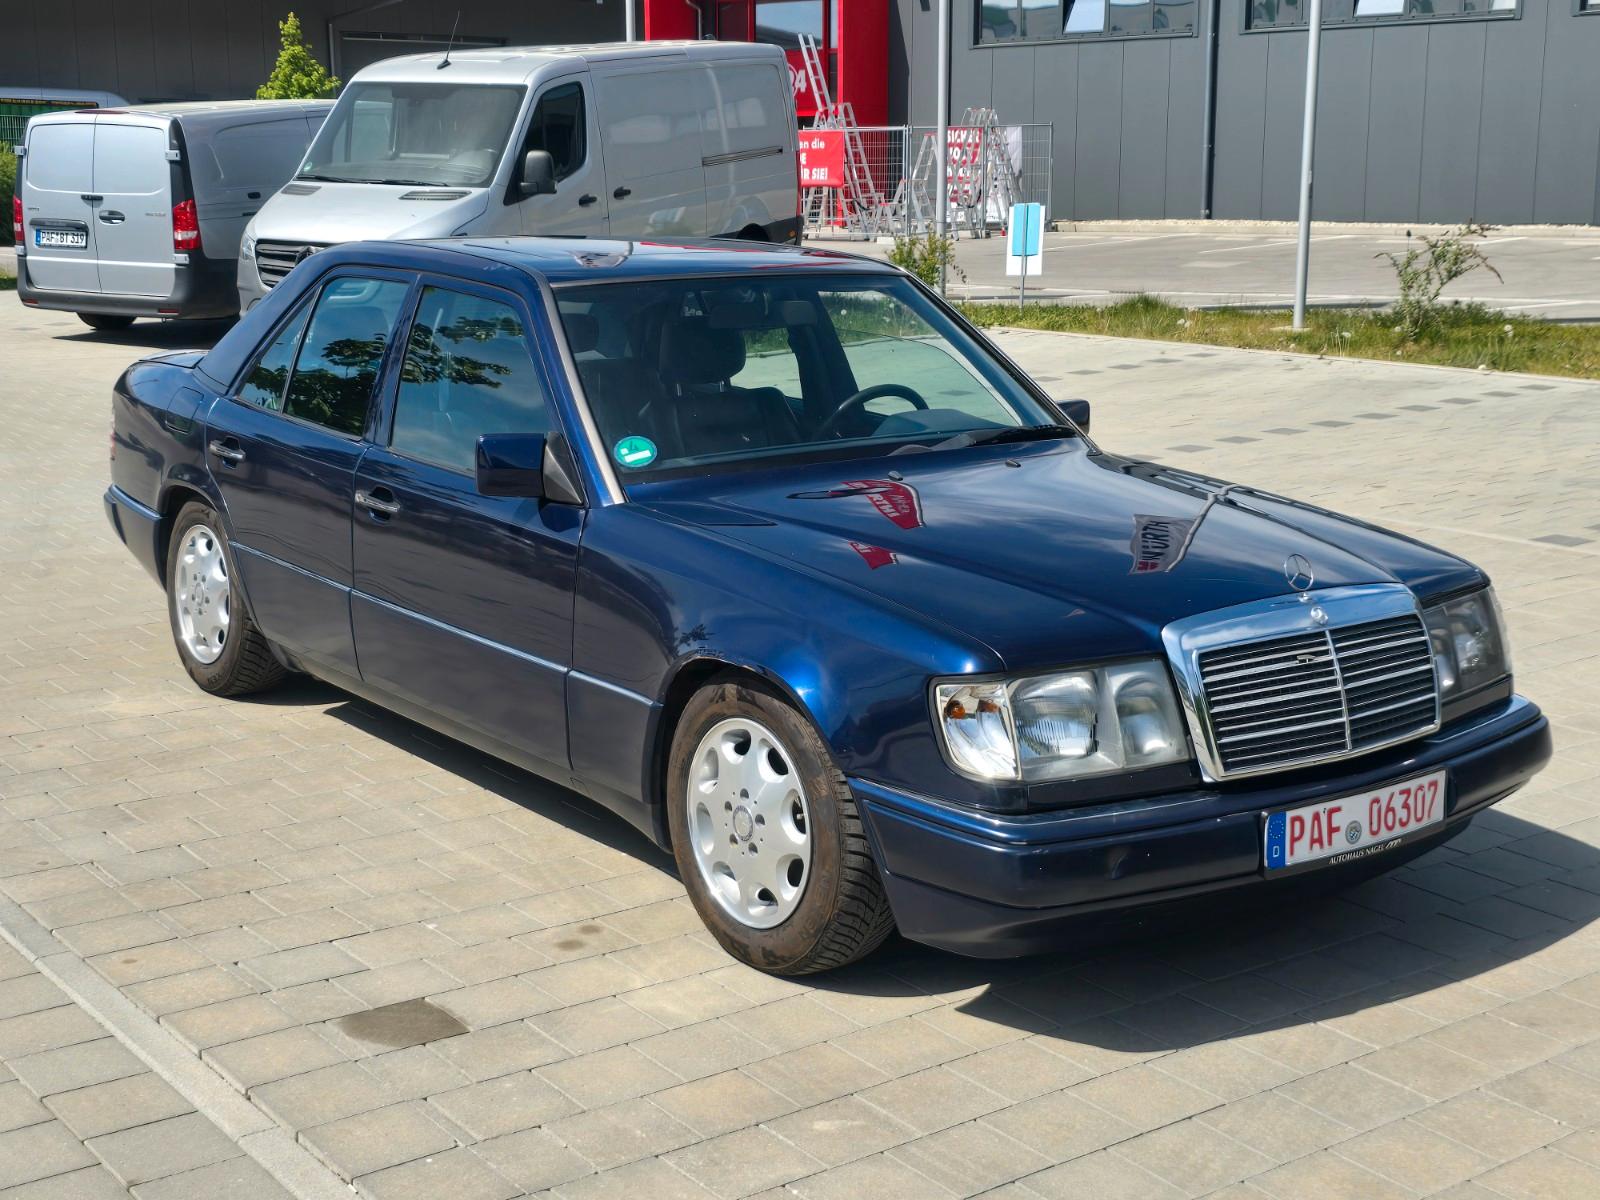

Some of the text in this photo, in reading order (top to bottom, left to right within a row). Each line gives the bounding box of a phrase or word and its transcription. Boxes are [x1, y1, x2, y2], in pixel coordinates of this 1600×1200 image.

[41, 231, 56, 242] PAF
[70, 232, 85, 243] 319
[1289, 779, 1438, 857] PAF 06307
[1328, 849, 1365, 865] AUTOHAUS
